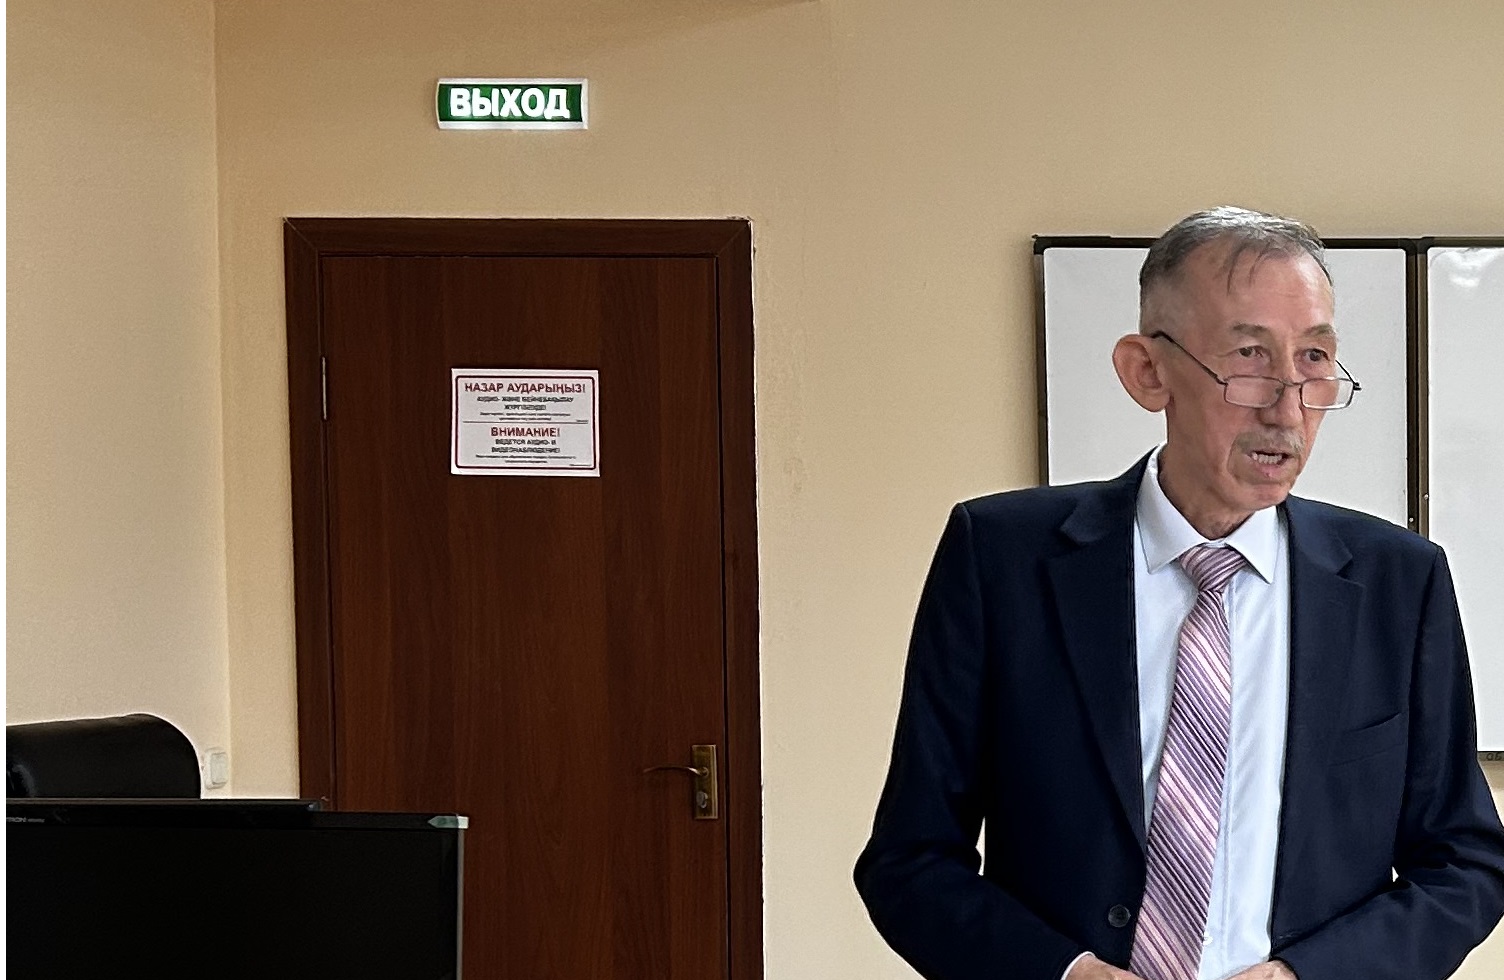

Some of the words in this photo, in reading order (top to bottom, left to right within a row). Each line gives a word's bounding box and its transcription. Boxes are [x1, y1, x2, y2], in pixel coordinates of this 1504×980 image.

[450, 87, 570, 120] ВЫХОД
[465, 382, 503, 393] НАЗАР
[507, 383, 586, 394] АУДАРЫҢЫЗ!
[491, 427, 560, 437] ВНИМАНИЕ!
